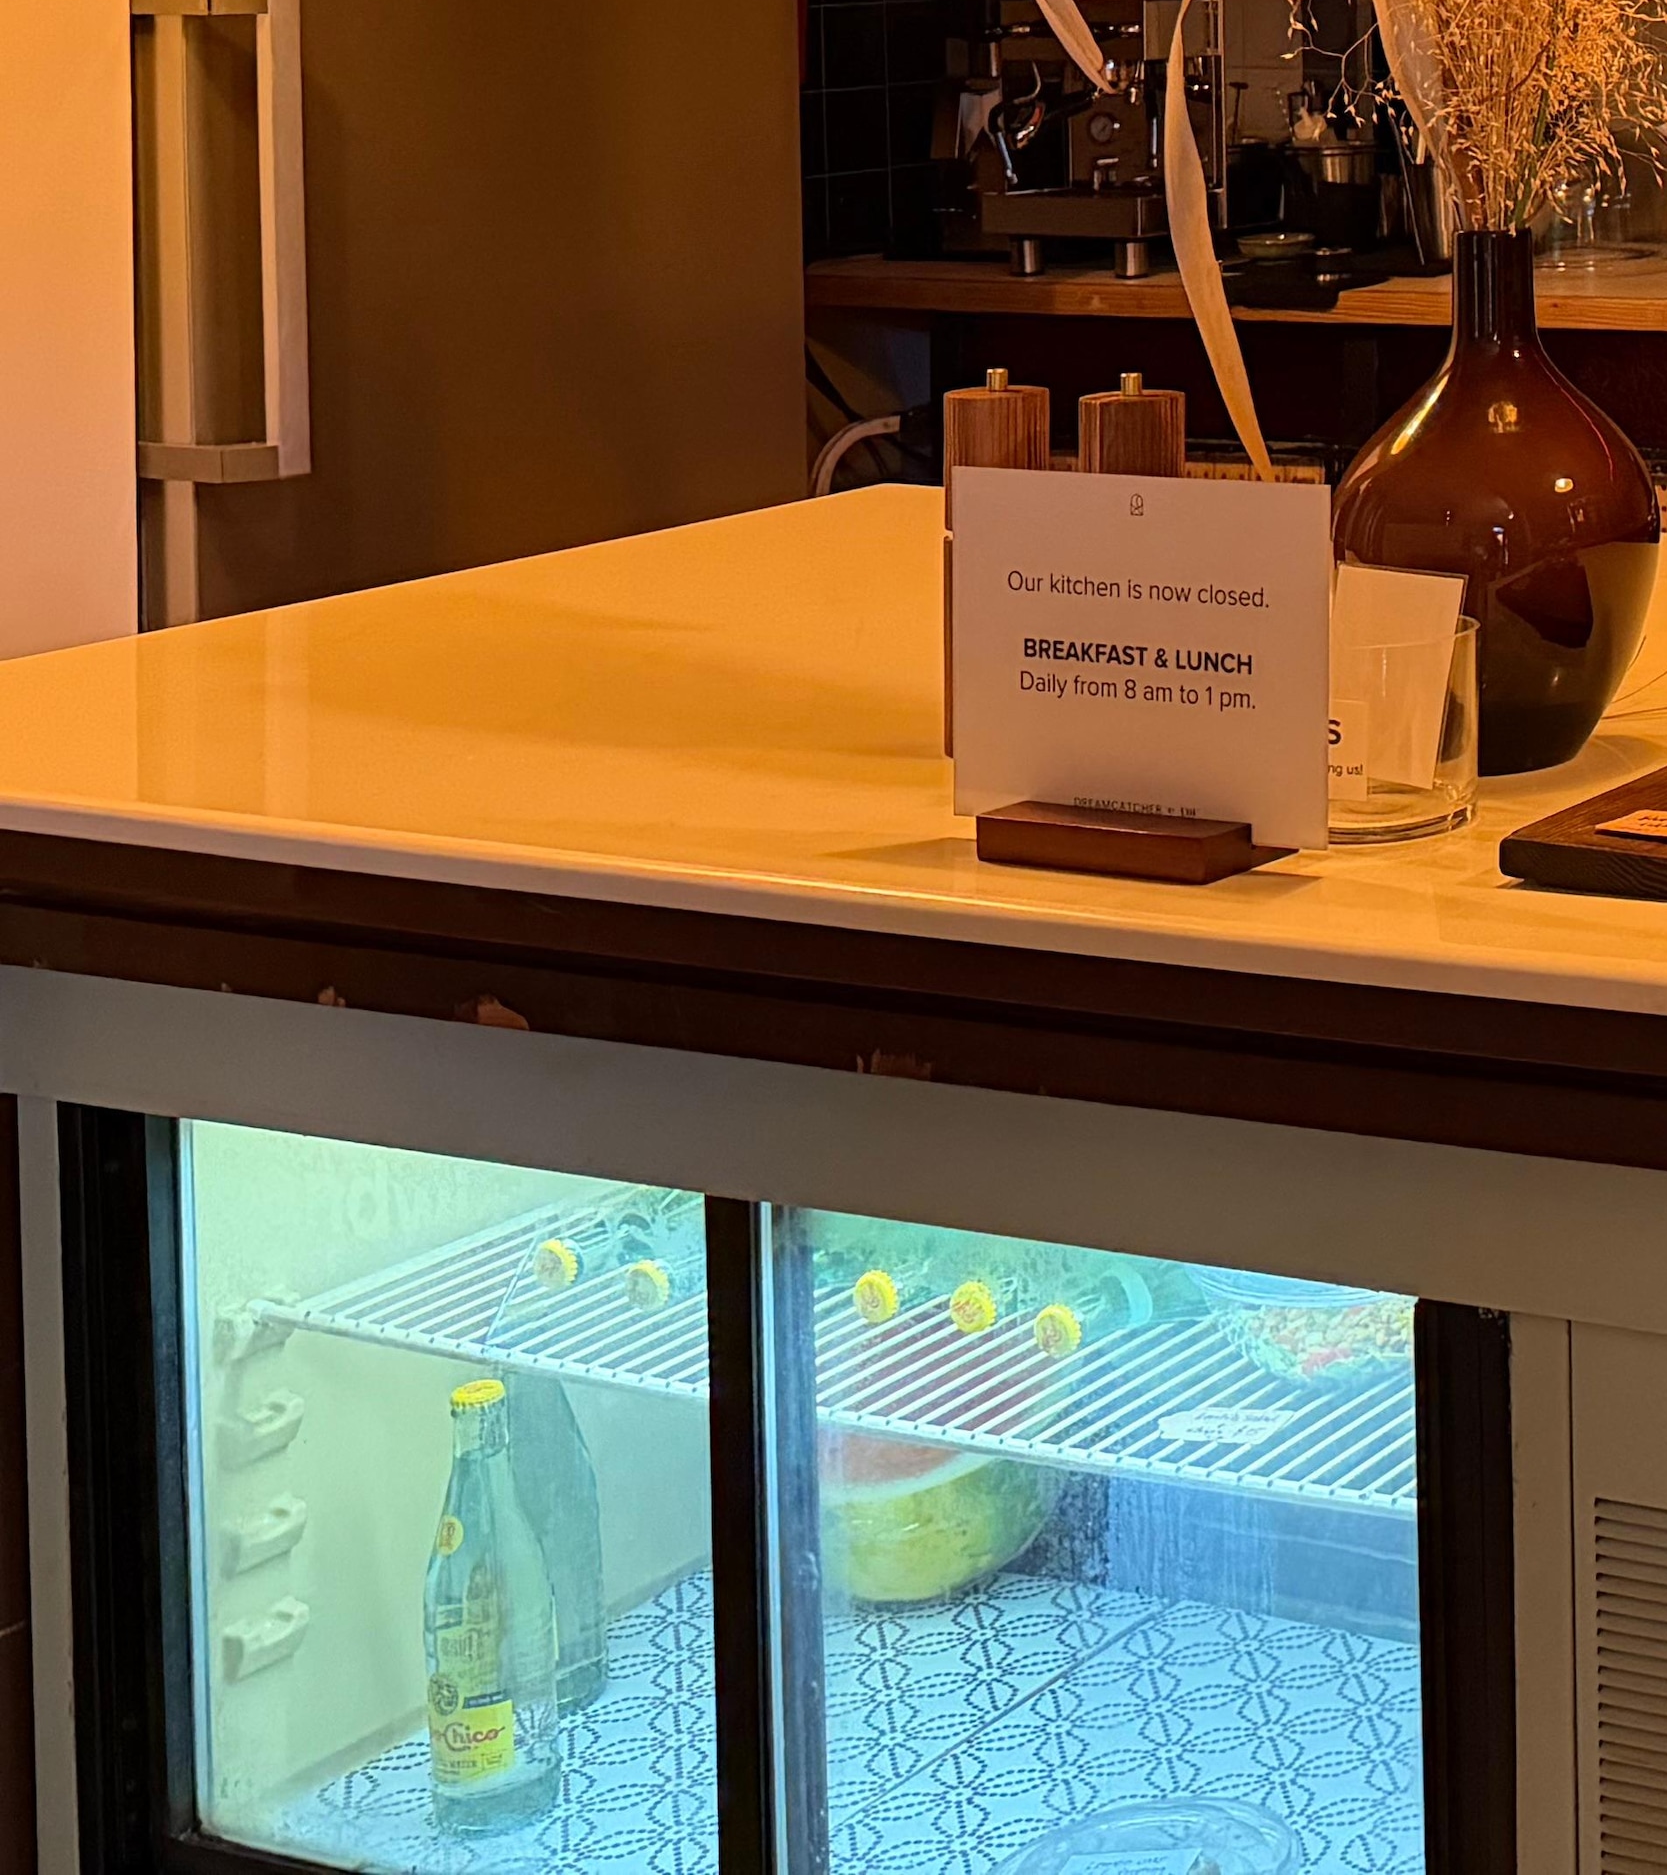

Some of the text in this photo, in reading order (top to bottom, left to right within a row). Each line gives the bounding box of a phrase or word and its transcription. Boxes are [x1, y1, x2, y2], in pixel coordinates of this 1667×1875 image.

[1007, 570, 1269, 608] Our kitchen is now closed.
[1023, 638, 1252, 674] BREAKFAST & LUNCH
[1020, 671, 1256, 712] Daily from 8 am to 1 pm.
[1346, 764, 1363, 776] us!
[445, 1721, 506, 1752] Chico
